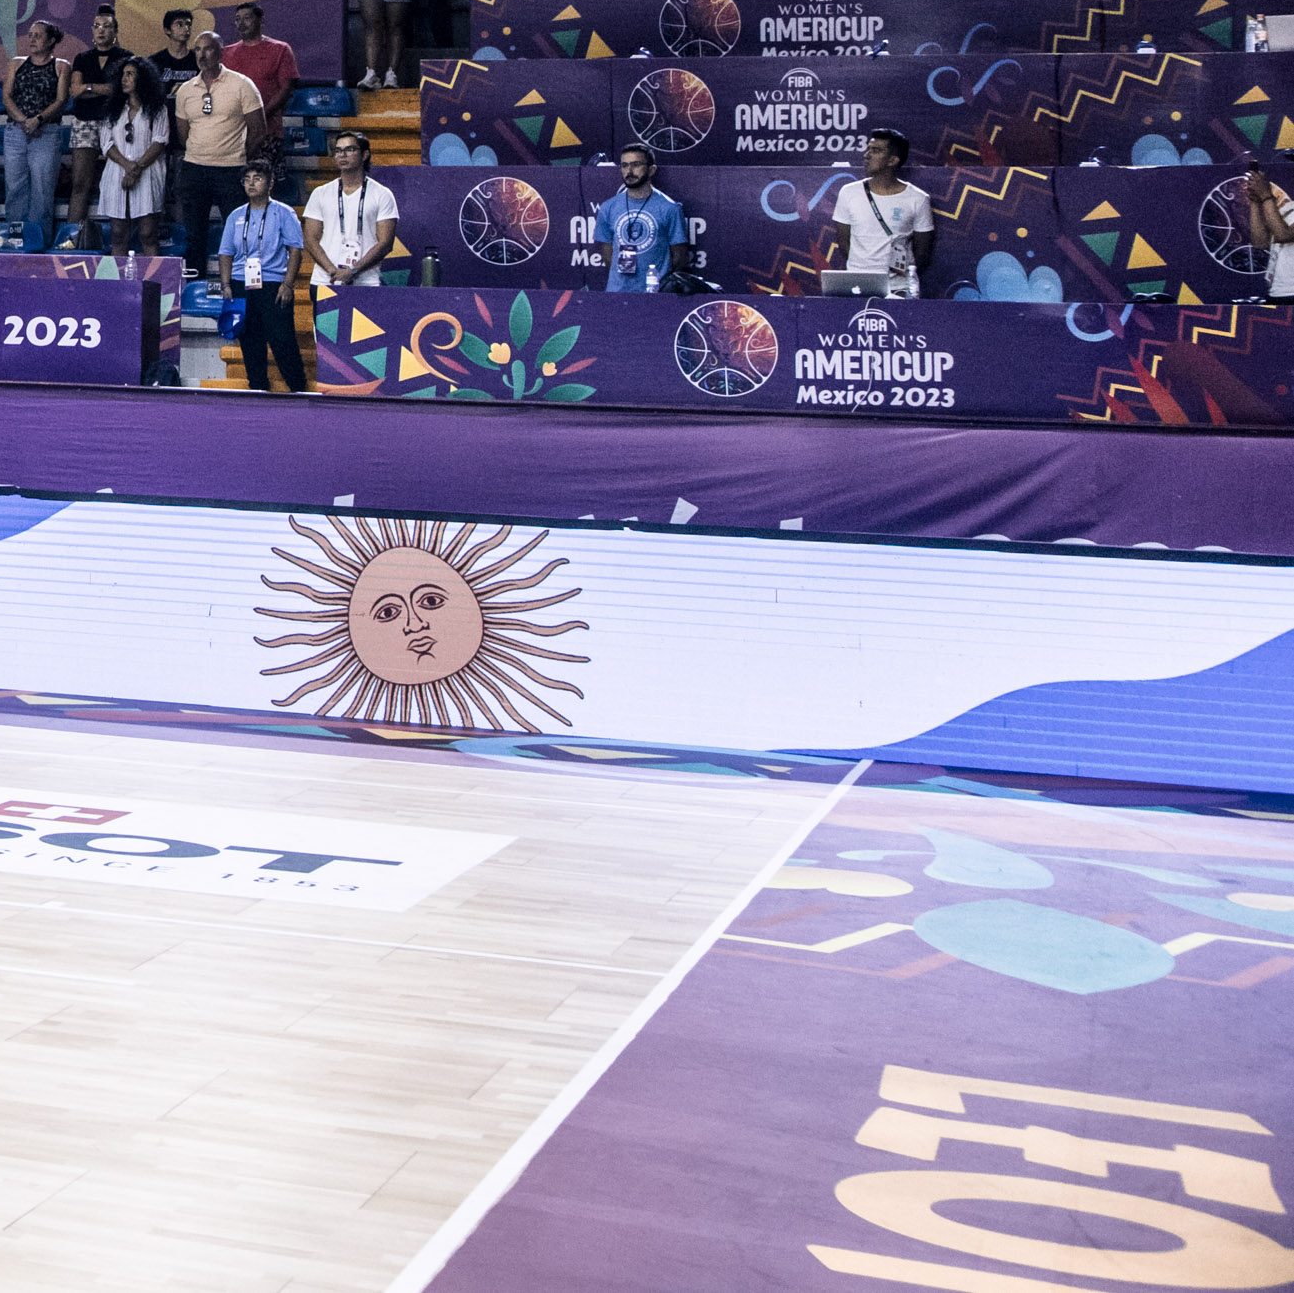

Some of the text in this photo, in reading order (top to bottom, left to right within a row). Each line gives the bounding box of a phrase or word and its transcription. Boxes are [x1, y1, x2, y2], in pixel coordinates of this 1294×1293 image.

[778, 3, 863, 15] WOMEN'S
[760, 16, 884, 42] AMERICUP
[788, 76, 813, 87] FIBA
[754, 90, 845, 102] WOMEN'S
[734, 104, 868, 131] AMERICUP
[736, 135, 867, 152] Mexico 2023
[3, 315, 103, 349] 2023
[858, 318, 887, 332] FIBA
[817, 333, 927, 348] WOMEN'S
[795, 349, 954, 382] AMERICUP
[796, 385, 955, 408] Mexico 2023
[221, 872, 360, 893] 1853
